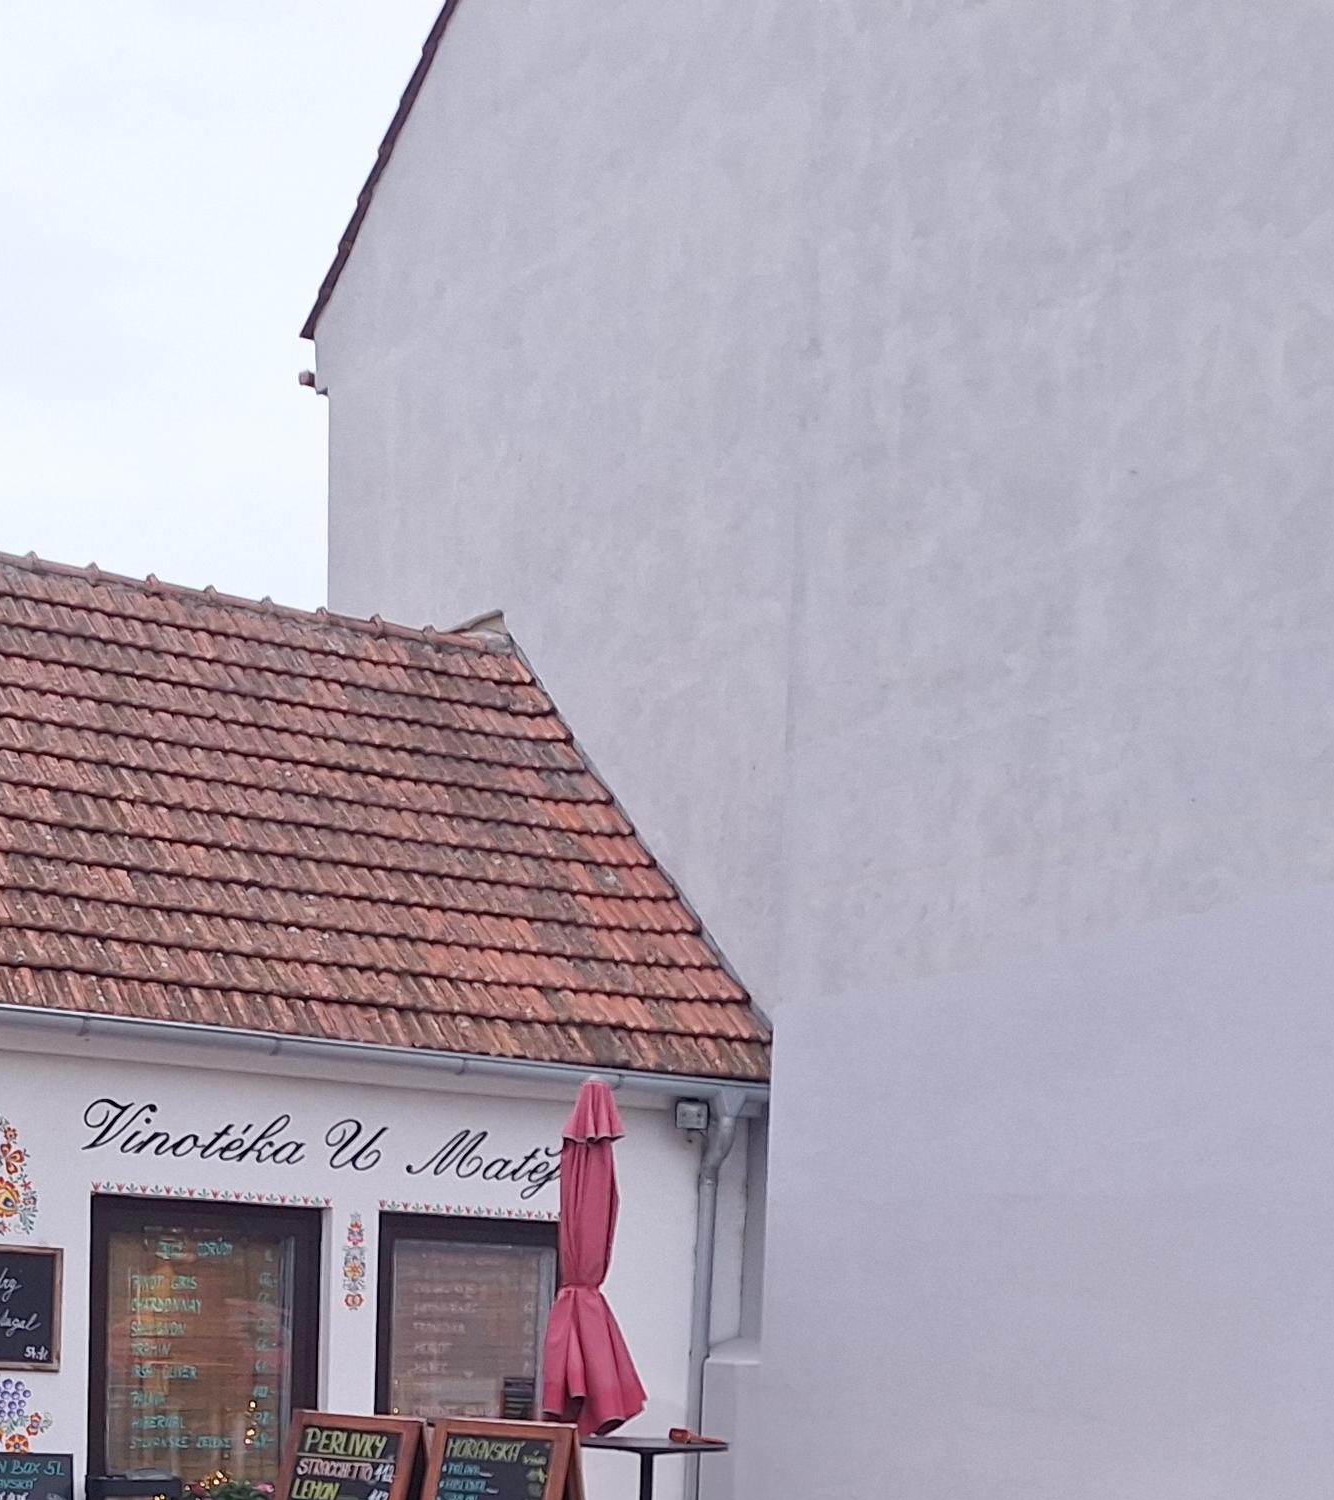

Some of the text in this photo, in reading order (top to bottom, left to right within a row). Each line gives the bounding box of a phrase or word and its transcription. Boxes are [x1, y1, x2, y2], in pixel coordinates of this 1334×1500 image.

[81, 1097, 563, 1200] Vinotéka U Matěj
[304, 1427, 388, 1459] PERLIVKY
[446, 1437, 527, 1462] MORAVSKÁ
